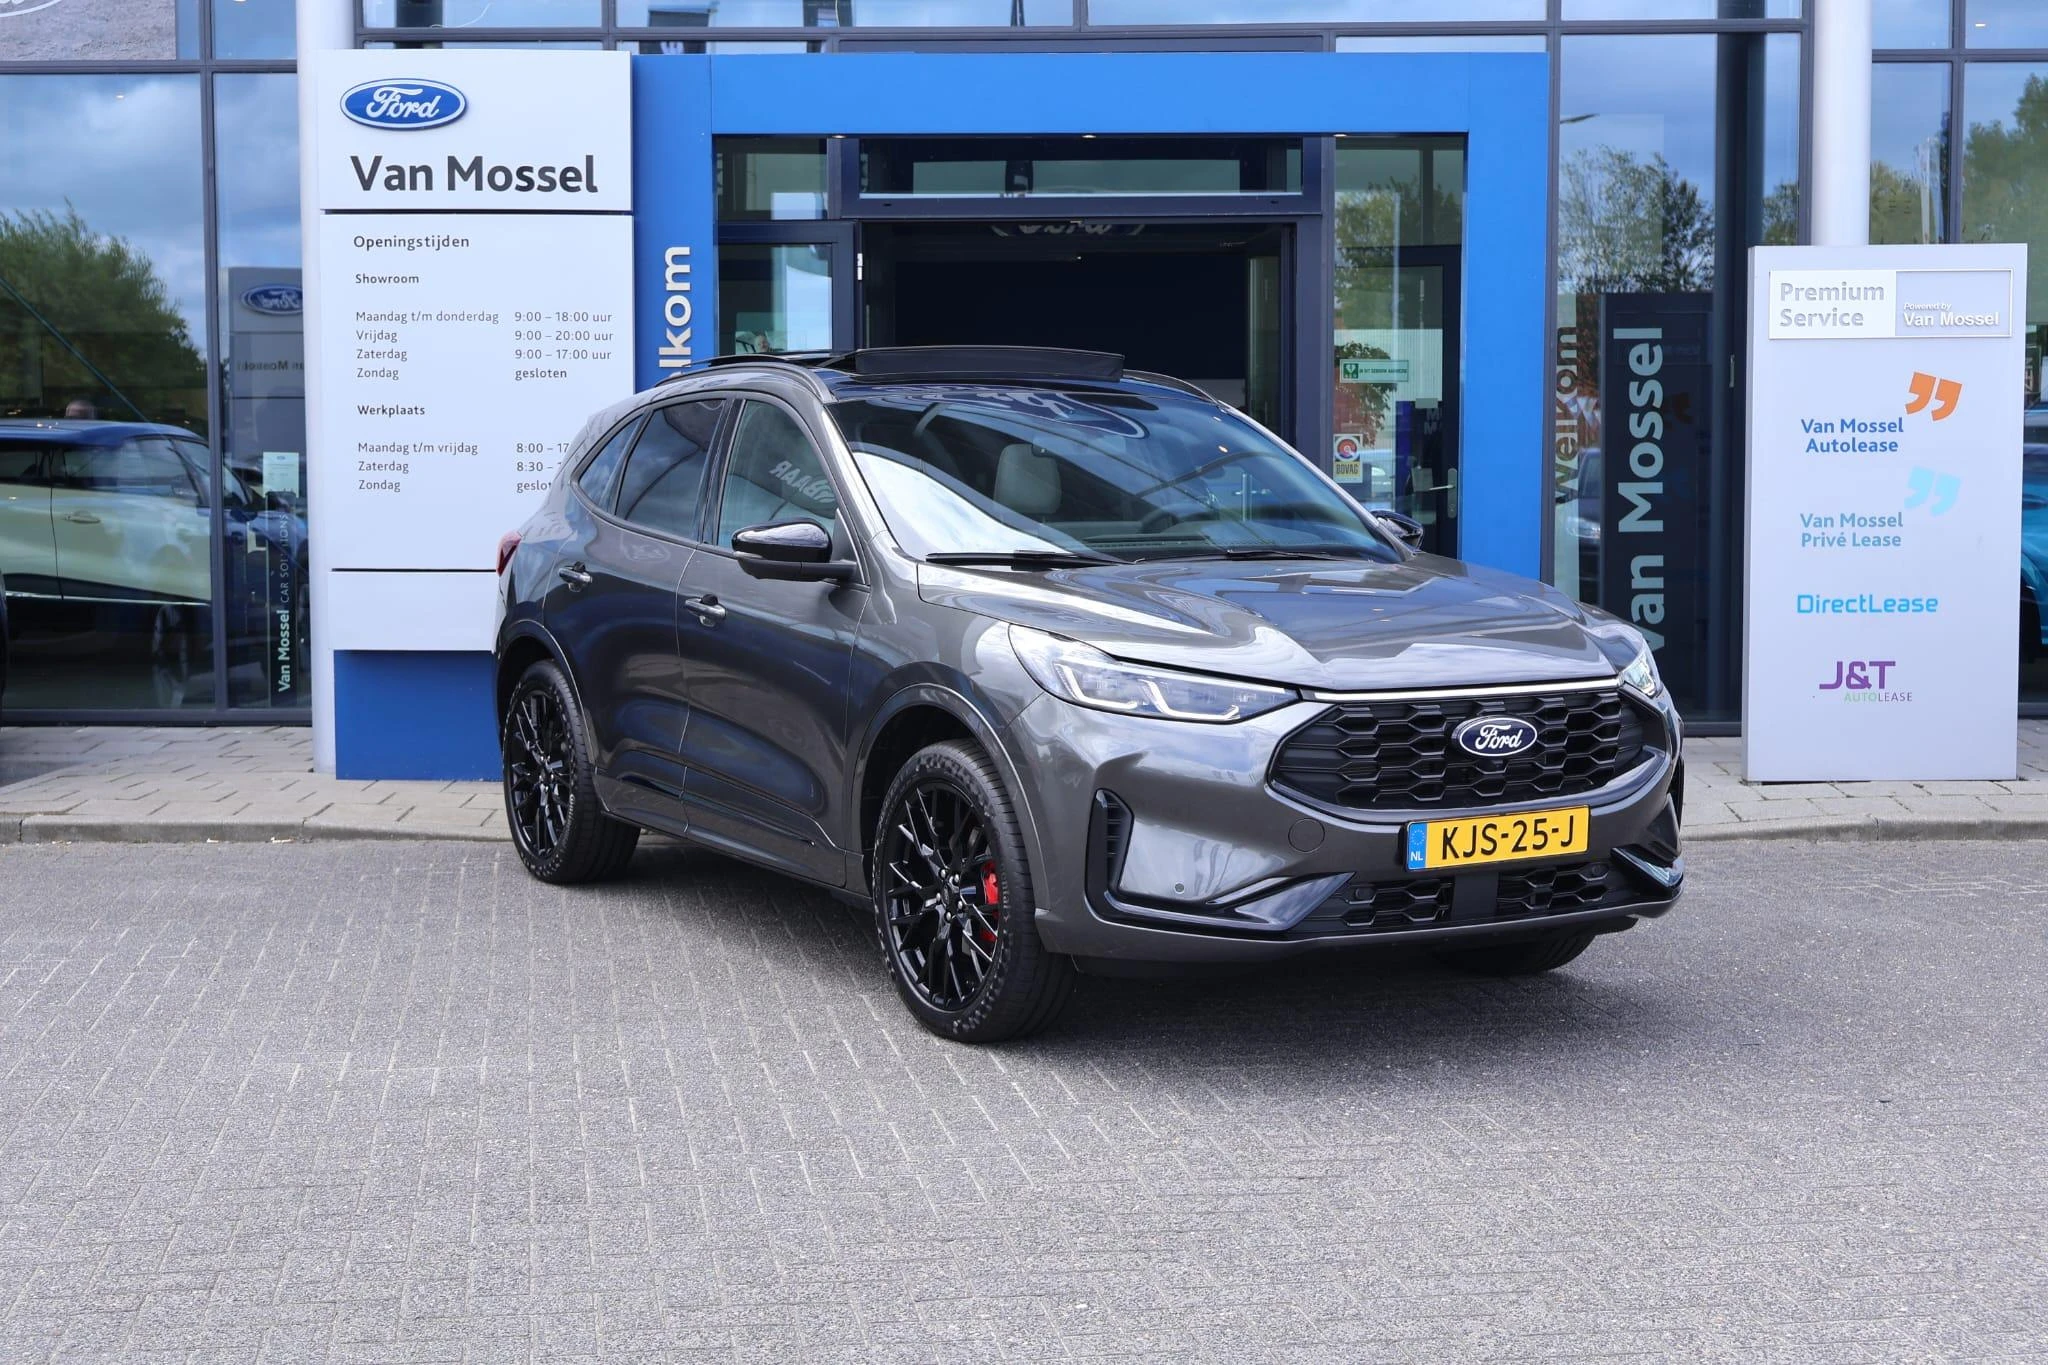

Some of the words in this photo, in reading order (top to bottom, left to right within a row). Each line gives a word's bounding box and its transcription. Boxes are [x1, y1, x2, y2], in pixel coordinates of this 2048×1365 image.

[366, 86, 441, 120] Ford
[350, 155, 433, 191] Van
[447, 154, 598, 193] Mossel
[354, 234, 469, 253] Openingstijden
[355, 273, 419, 284] Showroom
[1779, 281, 1885, 302] Premium
[659, 246, 692, 376] lkom
[1941, 302, 1952, 312] by
[356, 310, 408, 324] Maandag
[411, 311, 432, 322] t/m
[436, 310, 499, 324] donderdag
[515, 312, 541, 321] 9:00
[555, 312, 588, 322] 18:00
[593, 314, 612, 322] uur
[1779, 307, 1864, 327] Service
[1903, 313, 1934, 327] Van
[1940, 311, 2000, 327] Mossel
[355, 329, 398, 344] Vrijdag
[515, 330, 543, 341] 9:00
[556, 330, 591, 341] 20:00
[594, 333, 614, 341] uur
[356, 348, 407, 362] Zaterdag
[513, 349, 542, 359] 9:00
[556, 348, 588, 359] 17:00
[357, 367, 399, 381] Zondag
[515, 368, 567, 381] gesloten
[357, 404, 425, 418] Werkplaats
[1613, 328, 1664, 532] Mossel
[1801, 418, 1834, 434] Van
[1840, 417, 1904, 433] Mossel
[358, 442, 409, 455] Maandag
[413, 442, 434, 455] t/m
[438, 442, 478, 456] vrijdag
[516, 443, 544, 453] 8:00
[557, 442, 569, 453] 17
[1805, 437, 1898, 453] Autolease
[358, 460, 409, 474] Zaterdag
[517, 461, 543, 472] 8:30
[358, 480, 400, 493] Zondag
[516, 480, 551, 494] geslo
[1800, 513, 1834, 528] Van
[1840, 512, 1903, 528] Mossel
[280, 514, 289, 578] SOLIONS
[1802, 532, 1847, 547] Privé
[1852, 532, 1901, 547] Lease
[280, 582, 289, 604] CAR
[1797, 594, 1938, 613] DirectLease
[276, 609, 290, 661] Mossel
[278, 664, 291, 692] Van
[1819, 661, 1896, 690] J&T
[1844, 692, 1913, 703] AUTOLEASE
[1475, 724, 1523, 750] Ford
[1441, 815, 1574, 860] KJS-25-J
[1410, 850, 1424, 861] NL
